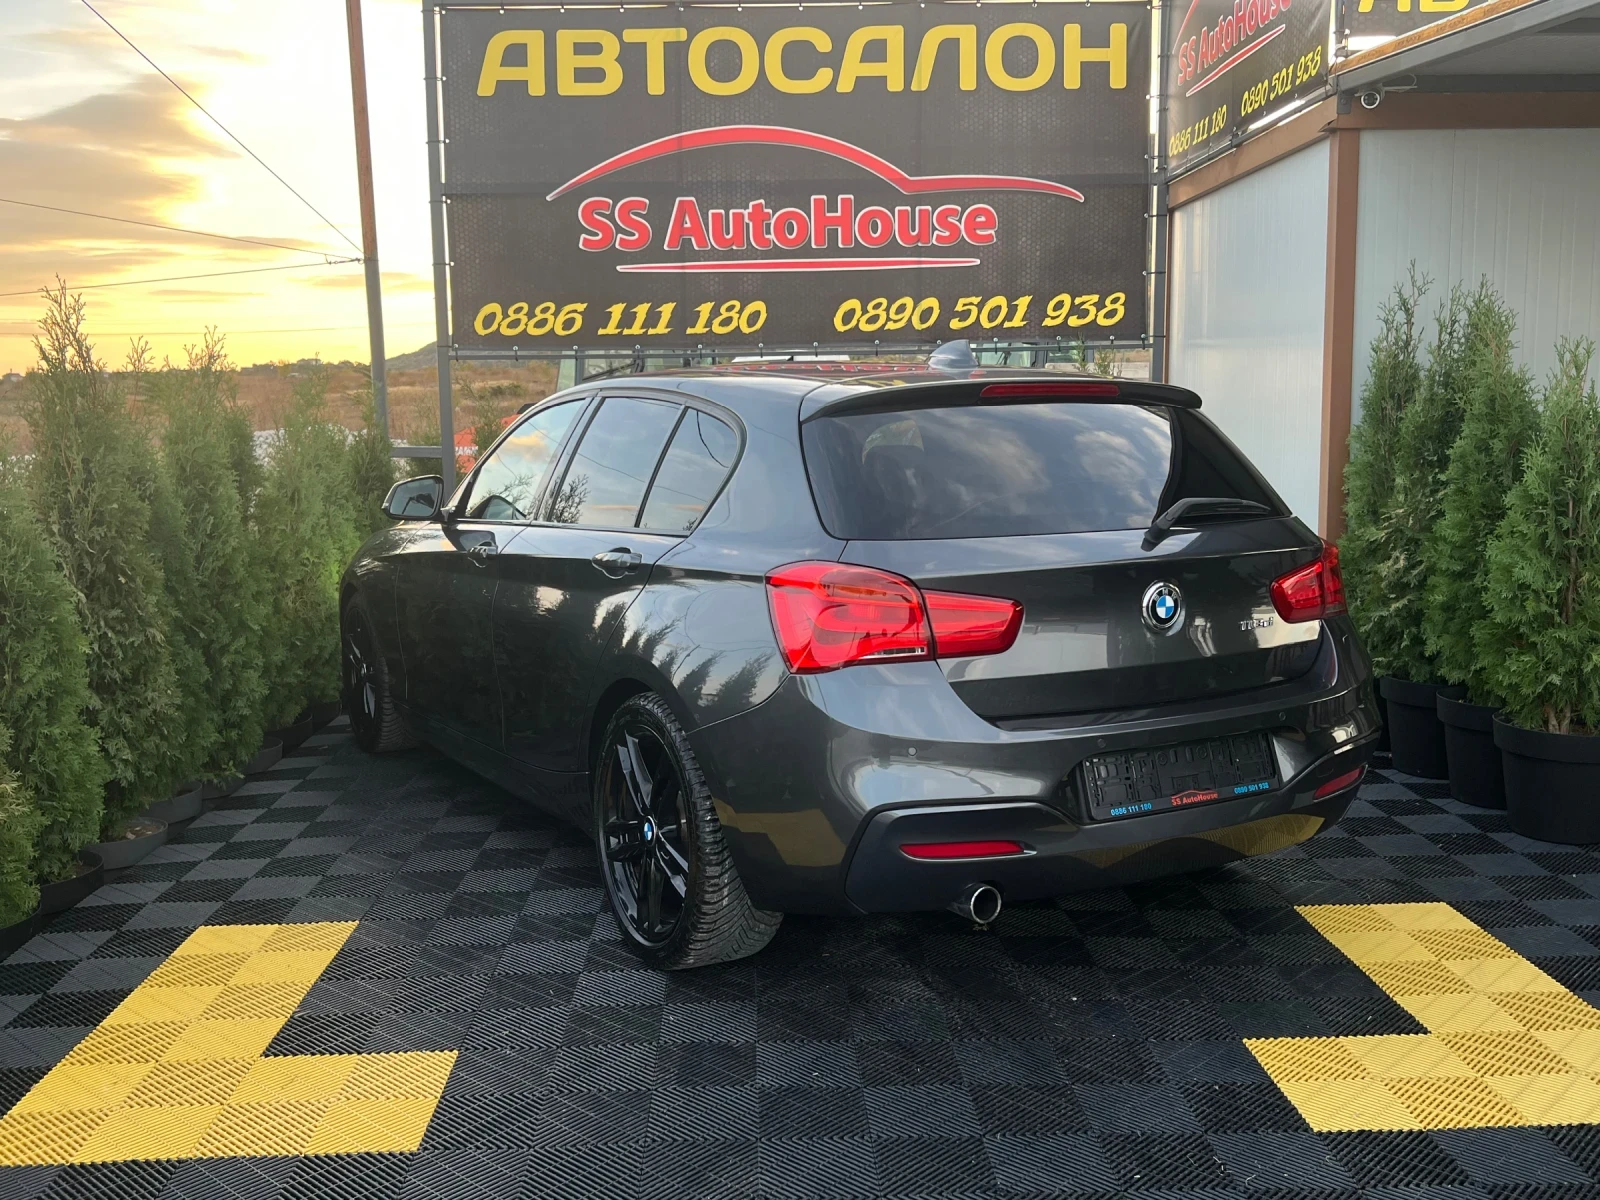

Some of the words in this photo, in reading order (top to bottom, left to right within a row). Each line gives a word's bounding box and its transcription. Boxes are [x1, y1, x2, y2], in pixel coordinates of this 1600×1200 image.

[476, 22, 1128, 97] АВТОСАЛОН
[1178, 35, 1197, 86] SS
[1241, 79, 1269, 117] 0890
[1270, 63, 1294, 101] 501
[1295, 45, 1322, 86] 938
[1168, 126, 1191, 157] 0886
[1192, 116, 1209, 145] 111
[1210, 104, 1227, 136] 180
[578, 196, 653, 252] SS
[663, 194, 999, 252] AutoHouse
[474, 301, 589, 337] 0886
[597, 301, 678, 336] 111
[685, 299, 768, 335] 180
[833, 296, 941, 333] 0890
[949, 294, 1034, 330] 501
[1041, 291, 1127, 328] 938
[1128, 804, 1139, 813] 111
[1182, 793, 1218, 805] AutoHouse
